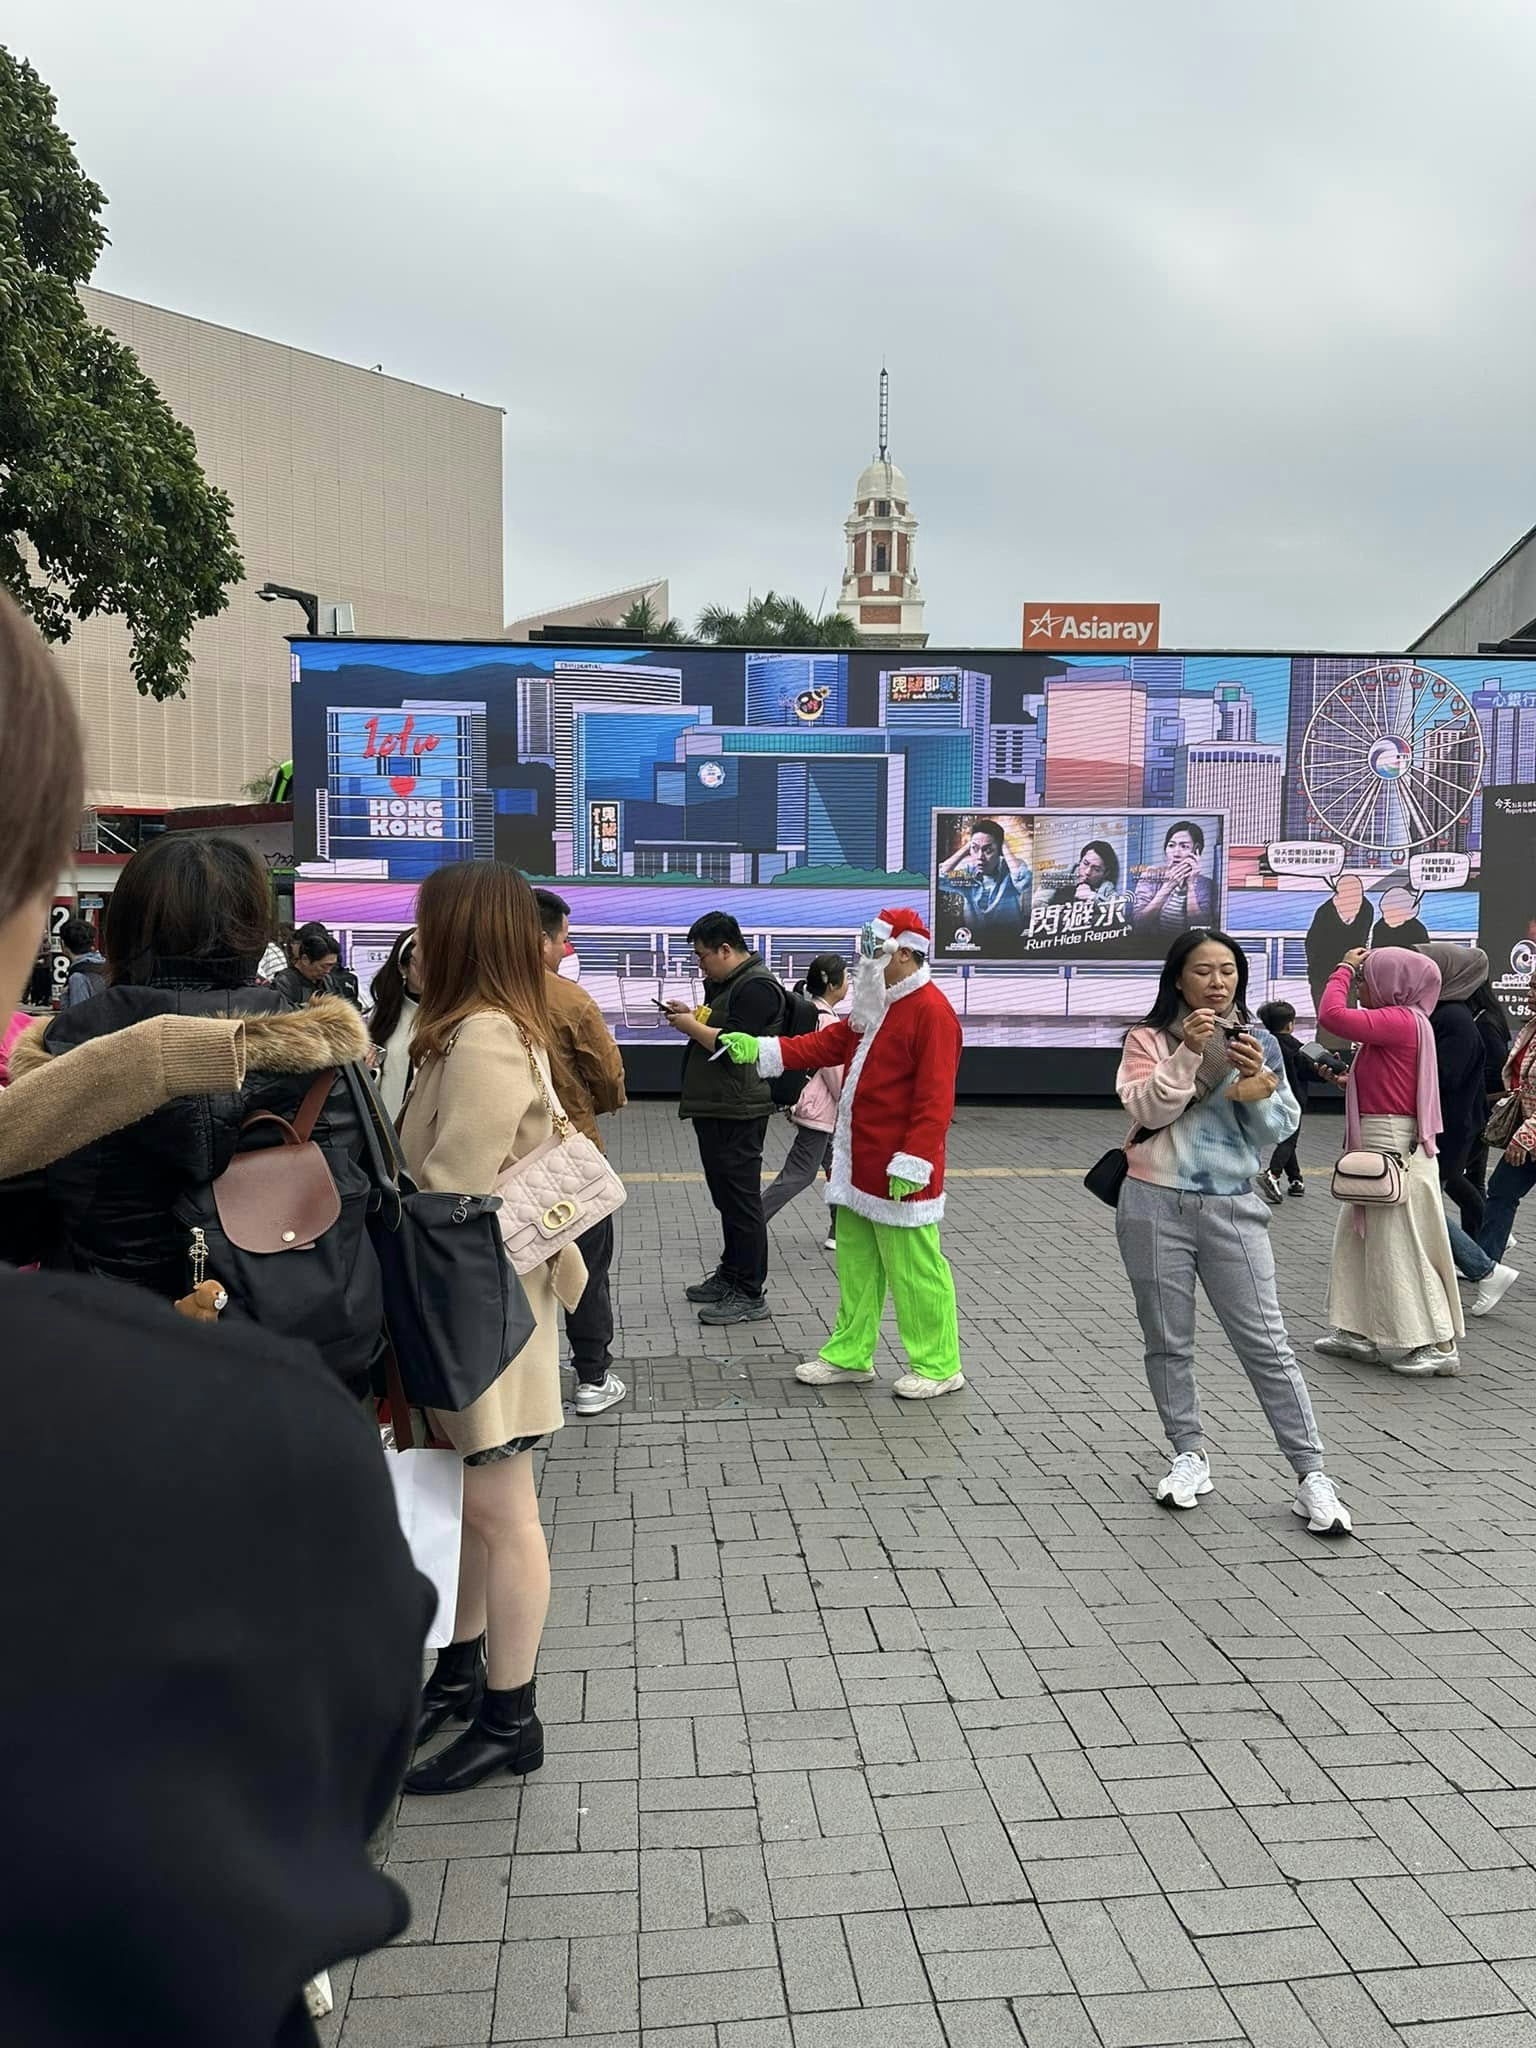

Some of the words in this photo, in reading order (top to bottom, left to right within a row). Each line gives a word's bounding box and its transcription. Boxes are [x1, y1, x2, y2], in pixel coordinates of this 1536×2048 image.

[1060, 615, 1153, 646] Asiaray
[369, 799, 443, 817] HONG
[369, 818, 443, 837] KONG
[1025, 938, 1054, 951] Run
[1054, 934, 1081, 947] Hide
[1084, 926, 1128, 943] Report
